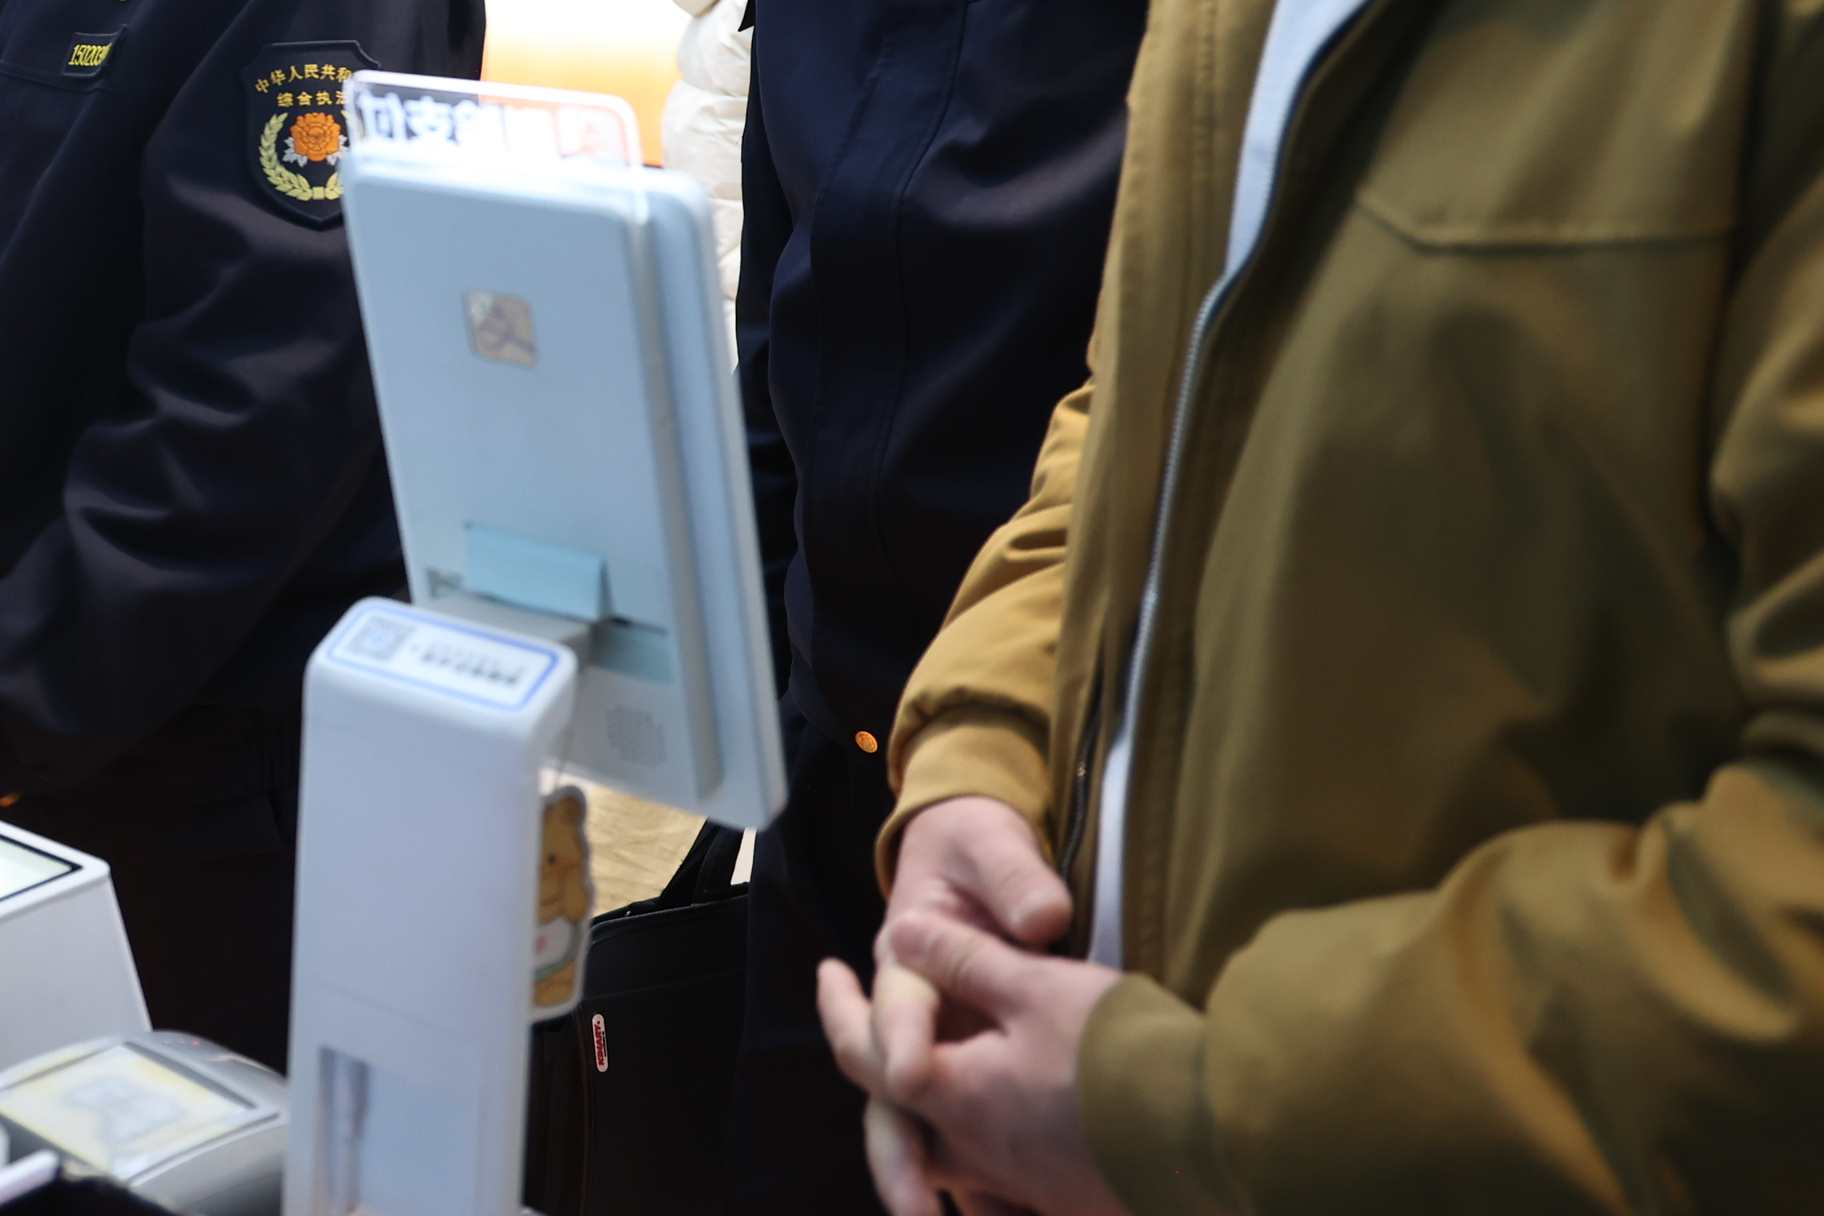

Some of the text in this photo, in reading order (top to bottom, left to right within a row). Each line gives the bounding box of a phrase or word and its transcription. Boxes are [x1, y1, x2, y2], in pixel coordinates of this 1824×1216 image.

[255, 64, 353, 93] 中华人民共和
